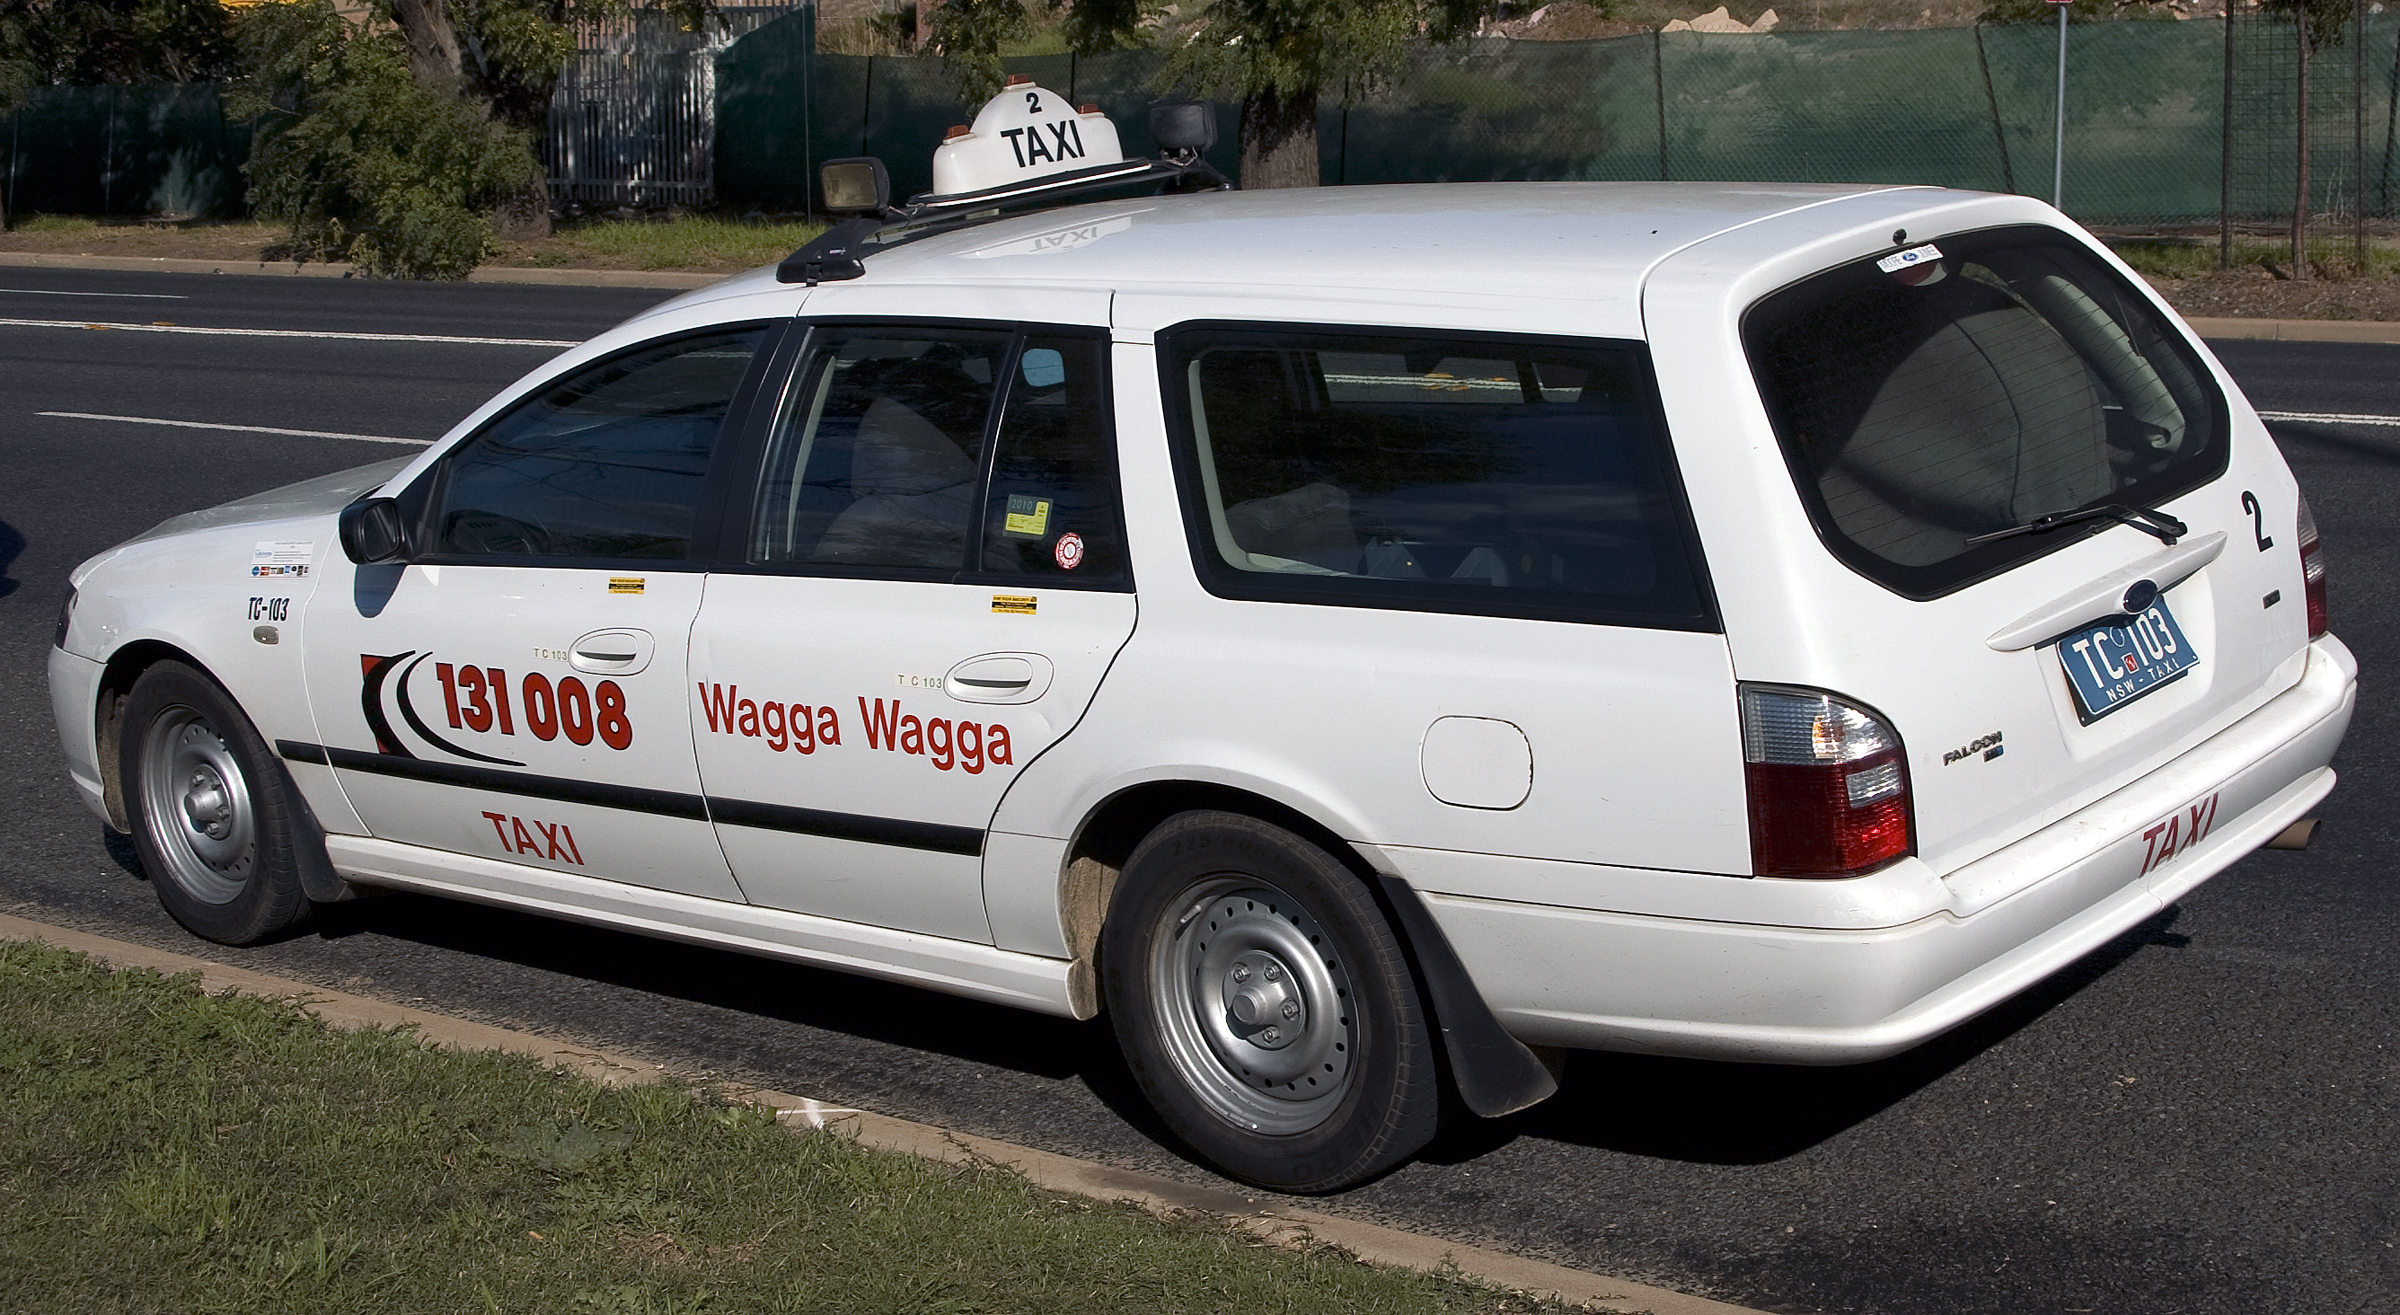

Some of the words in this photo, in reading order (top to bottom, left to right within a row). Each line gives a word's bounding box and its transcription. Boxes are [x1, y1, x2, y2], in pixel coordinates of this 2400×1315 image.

[1026, 92, 1042, 114] 2
[1000, 119, 1085, 168] TAXI
[1011, 499, 1033, 511] 2010
[2241, 490, 2274, 552] 2
[248, 596, 290, 622] TC-103
[2072, 631, 2124, 689] TC
[2126, 607, 2177, 667] 103
[923, 677, 942, 688] 103
[2106, 679, 2135, 702] NSW
[2147, 657, 2180, 681] TAXI
[435, 662, 515, 736] 131
[522, 672, 633, 751] 008
[698, 682, 842, 755] Wagga
[857, 696, 1013, 774] Wagga
[1943, 730, 2003, 766] FALCON
[481, 810, 584, 866] TAXI
[2138, 791, 2219, 880] TAXI
